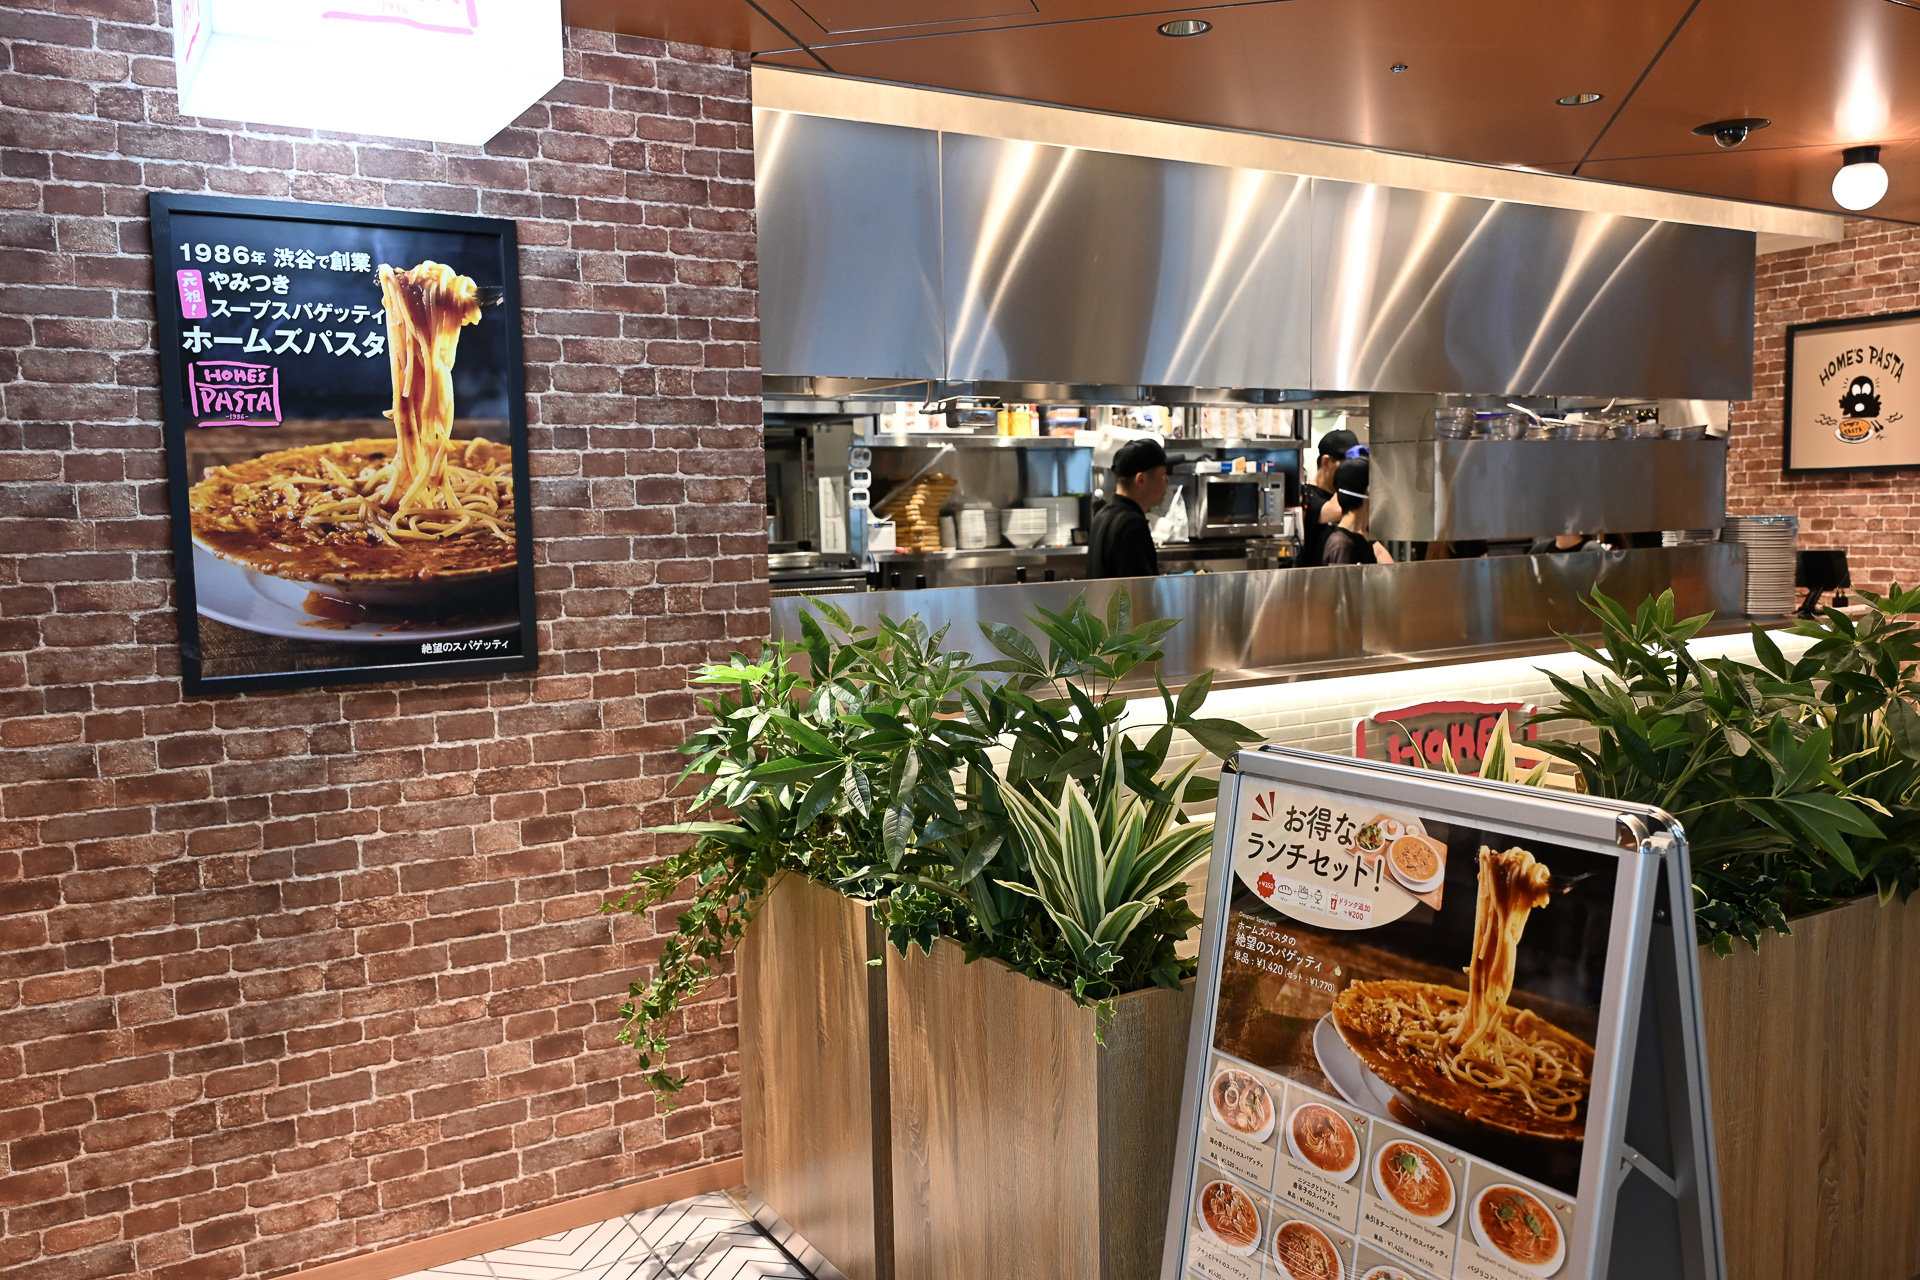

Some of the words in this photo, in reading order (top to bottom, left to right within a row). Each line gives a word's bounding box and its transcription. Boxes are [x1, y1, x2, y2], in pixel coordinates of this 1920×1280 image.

[180, 243, 266, 266] 1986年
[273, 247, 372, 273] 渋谷で創業
[208, 270, 291, 295] やみつき
[211, 299, 386, 325] スープスパゲッティ
[182, 326, 386, 359] ホームズパスタ
[1819, 348, 1864, 386] HOME'S
[1869, 345, 1905, 383] PASTA
[198, 387, 273, 413] PASTA
[421, 640, 509, 654] 絶望のスパゲッティ
[1283, 805, 1357, 846] お得な
[1237, 920, 1297, 947] ホームズパスタの
[1234, 931, 1322, 973] 絶望のスパゲッティ
